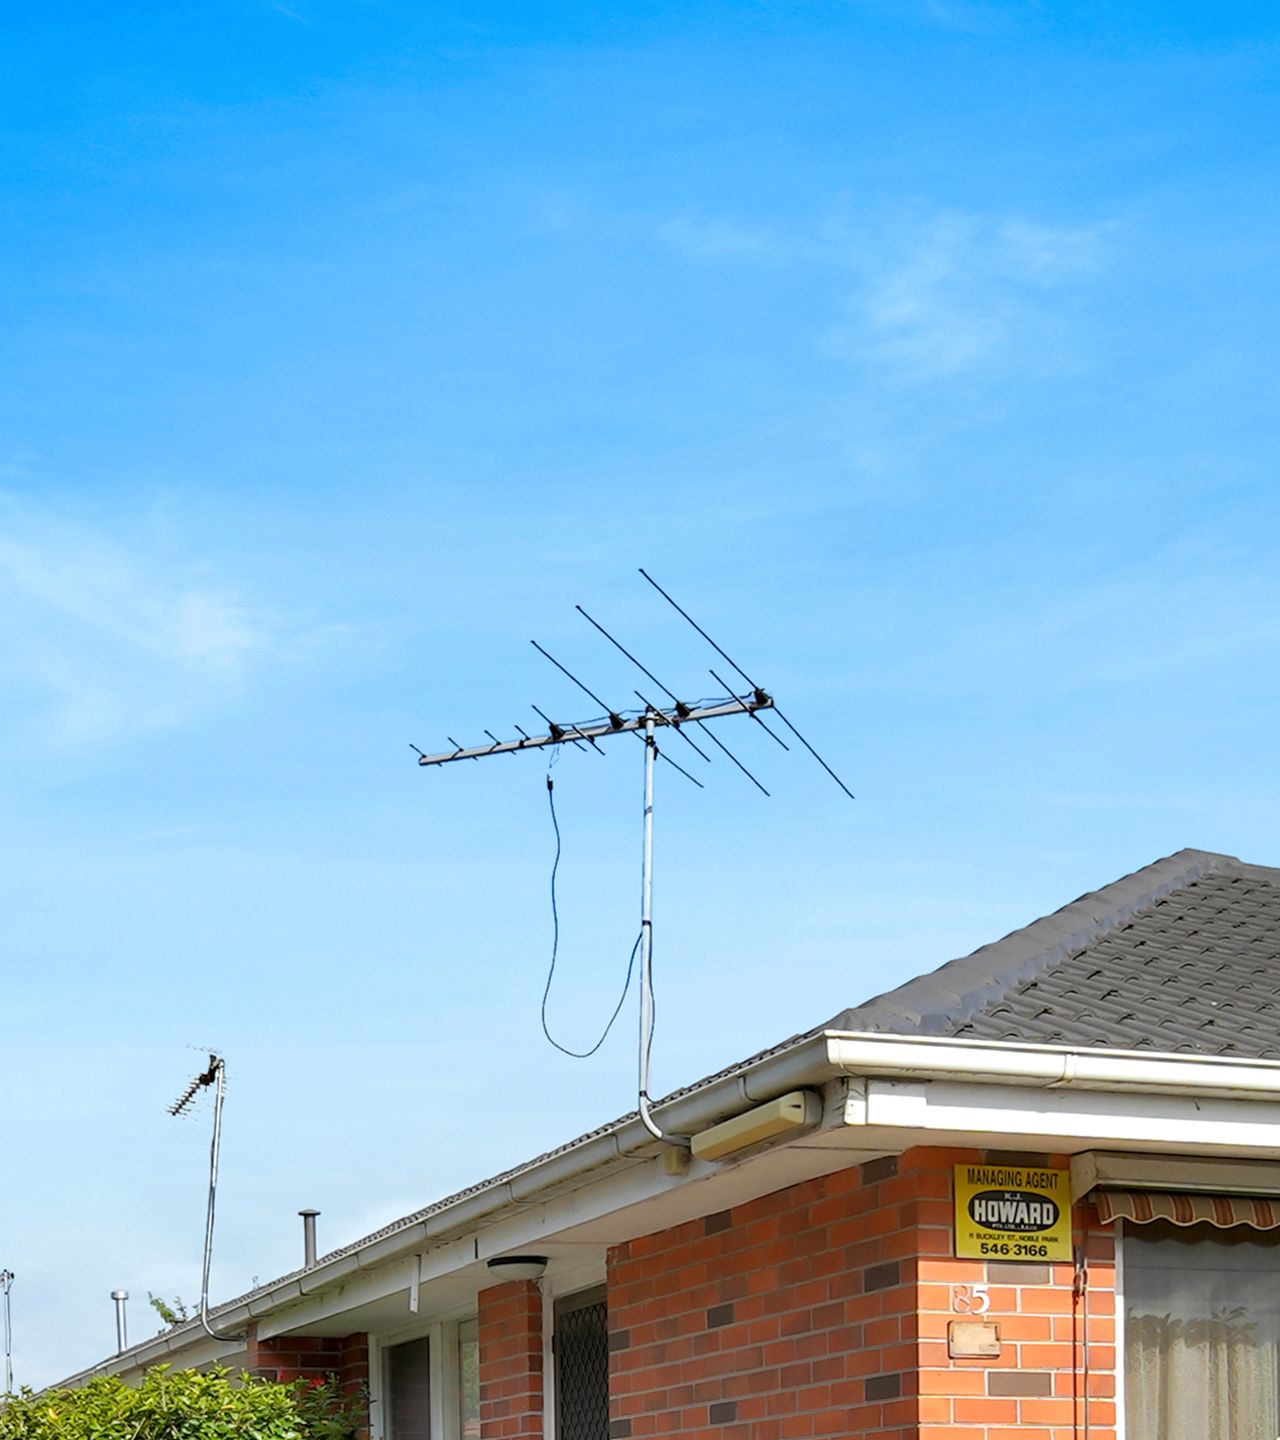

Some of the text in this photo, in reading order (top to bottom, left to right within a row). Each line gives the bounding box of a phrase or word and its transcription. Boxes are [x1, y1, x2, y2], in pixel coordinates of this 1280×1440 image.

[967, 1168, 1059, 1189] MANAGING AGENT
[974, 1199, 1055, 1226] HOWARD
